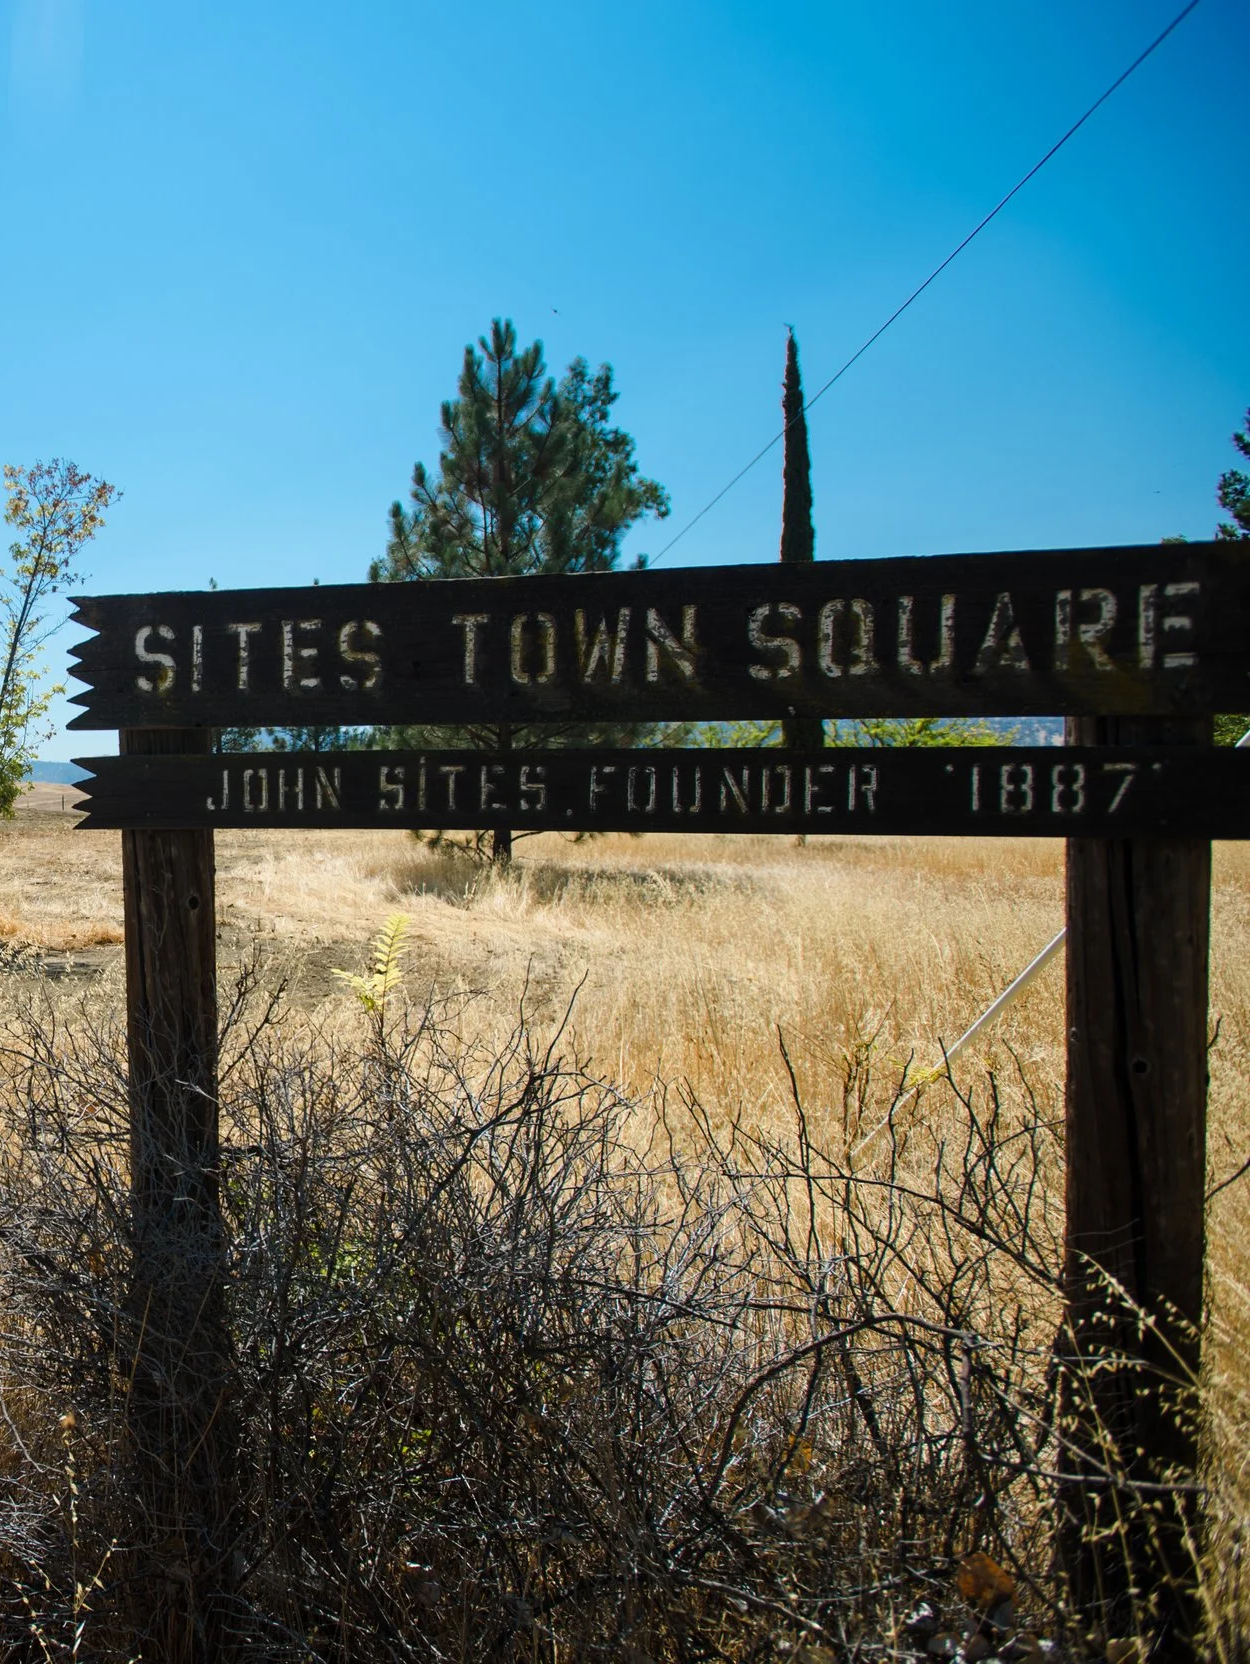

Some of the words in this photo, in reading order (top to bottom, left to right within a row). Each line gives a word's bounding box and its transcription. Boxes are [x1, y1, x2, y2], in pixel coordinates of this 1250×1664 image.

[132, 619, 384, 694] SITES
[451, 605, 699, 685] TOWN
[748, 581, 1200, 679] SQUARE
[206, 765, 342, 812] JOHN
